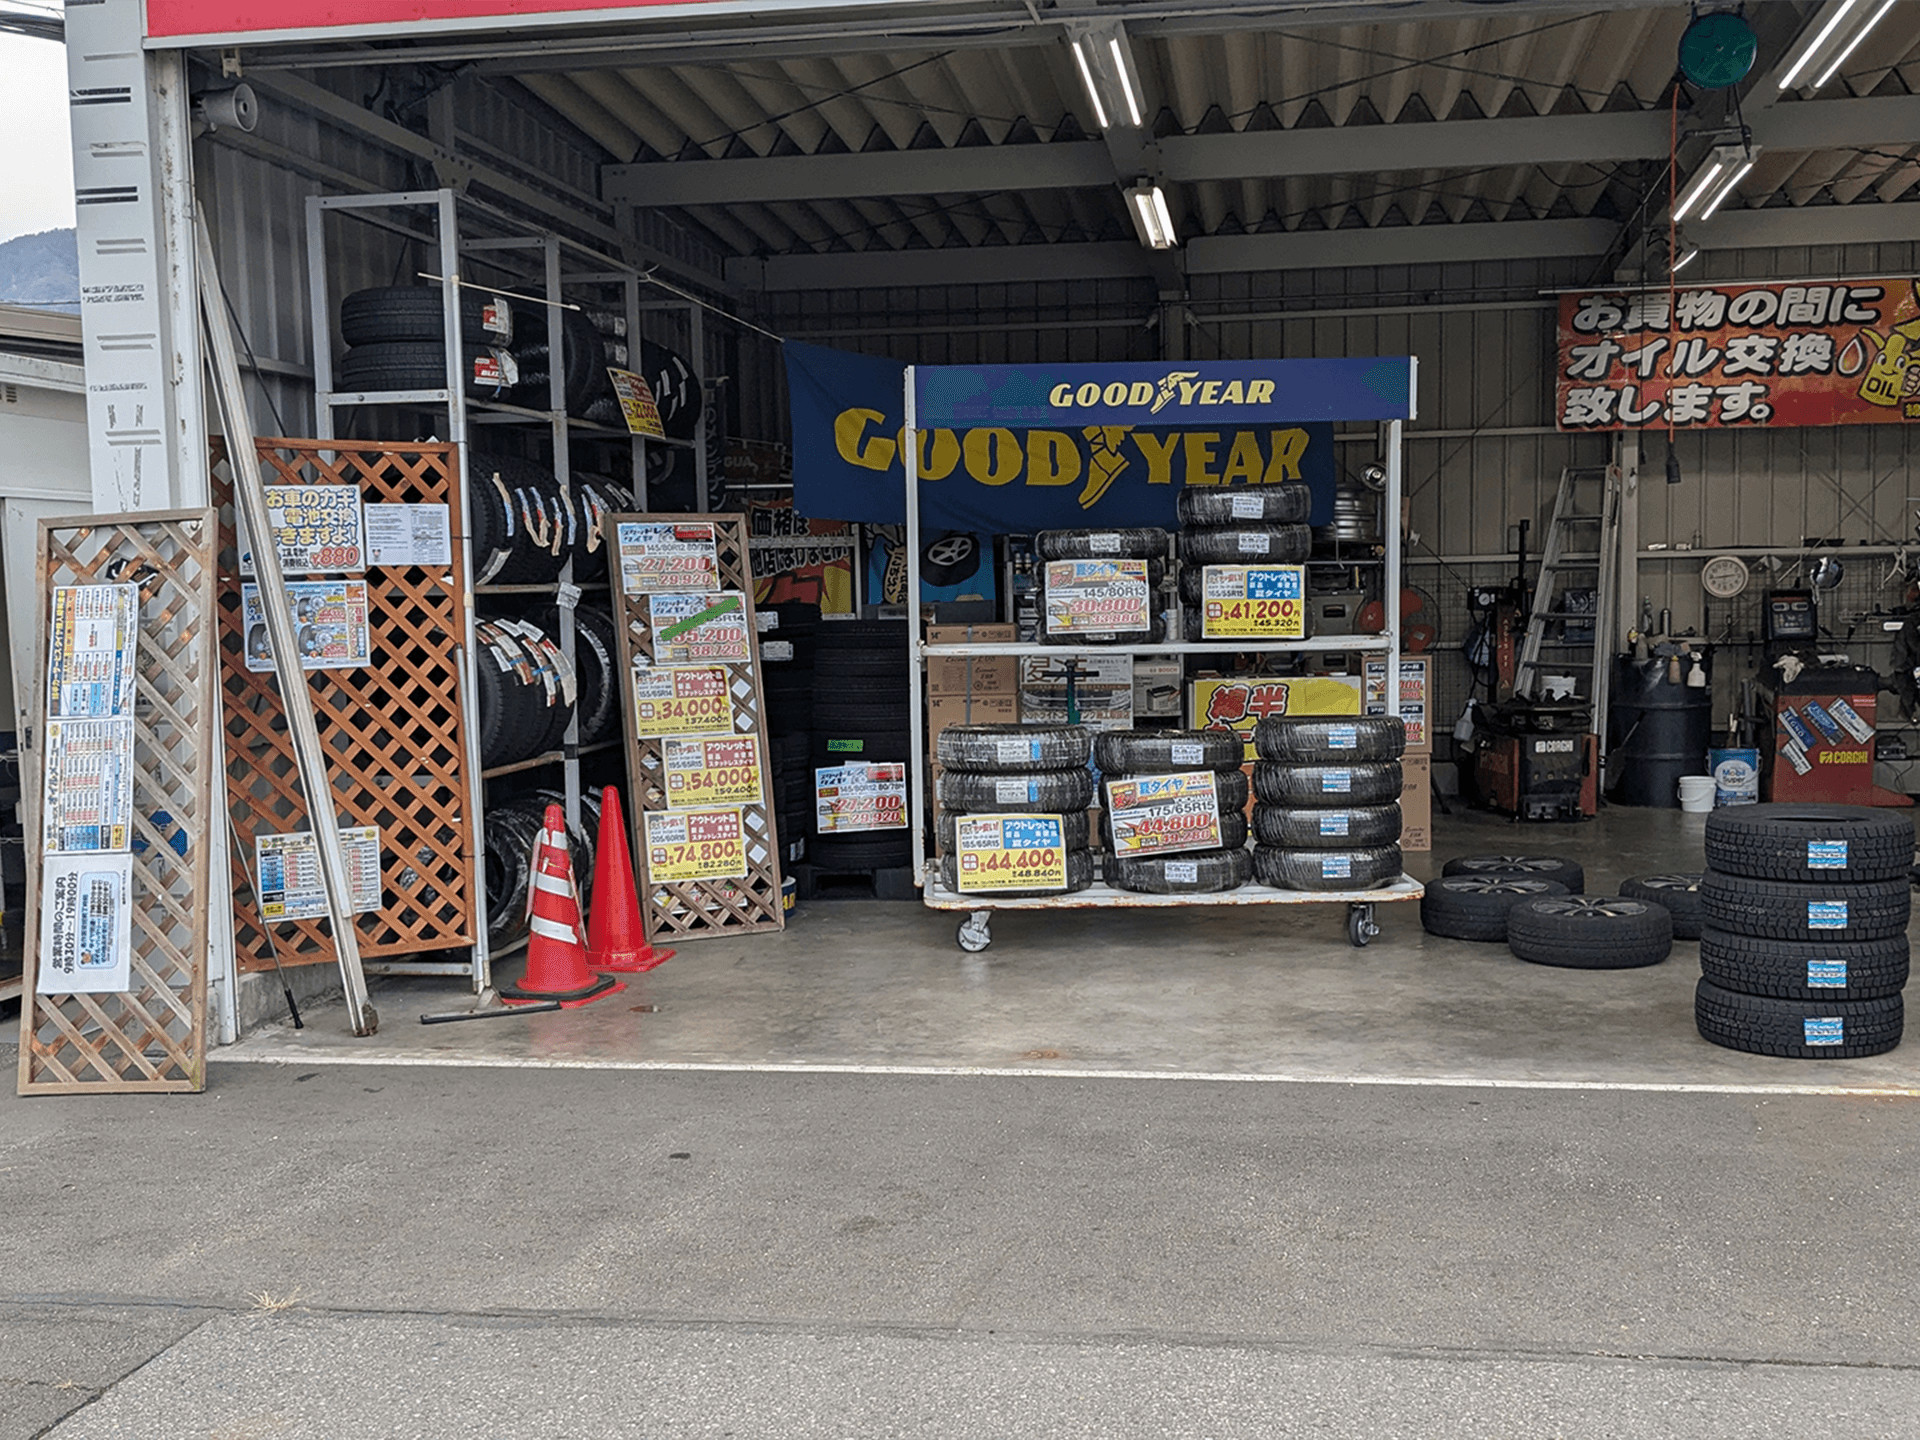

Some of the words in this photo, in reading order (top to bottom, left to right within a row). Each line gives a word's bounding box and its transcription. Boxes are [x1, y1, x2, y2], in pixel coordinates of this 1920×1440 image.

[1572, 287, 1882, 331] お買物の間に
[1567, 333, 1834, 379] オイル交換
[1867, 377, 1896, 400] OIL
[1562, 381, 1773, 425] 致します。
[265, 489, 356, 509] お車のカギ
[284, 508, 357, 527] 電池交換
[752, 506, 811, 537] 価格は
[1083, 587, 1147, 598] 145/80R13
[1834, 751, 1868, 763] CORGHI
[1722, 768, 1746, 777] Mobil
[1722, 776, 1746, 785] Super
[1138, 779, 1184, 795] 夏タイヤ
[1148, 801, 1216, 818] 175/65R15
[51, 876, 67, 970] 営業時間のご案内
